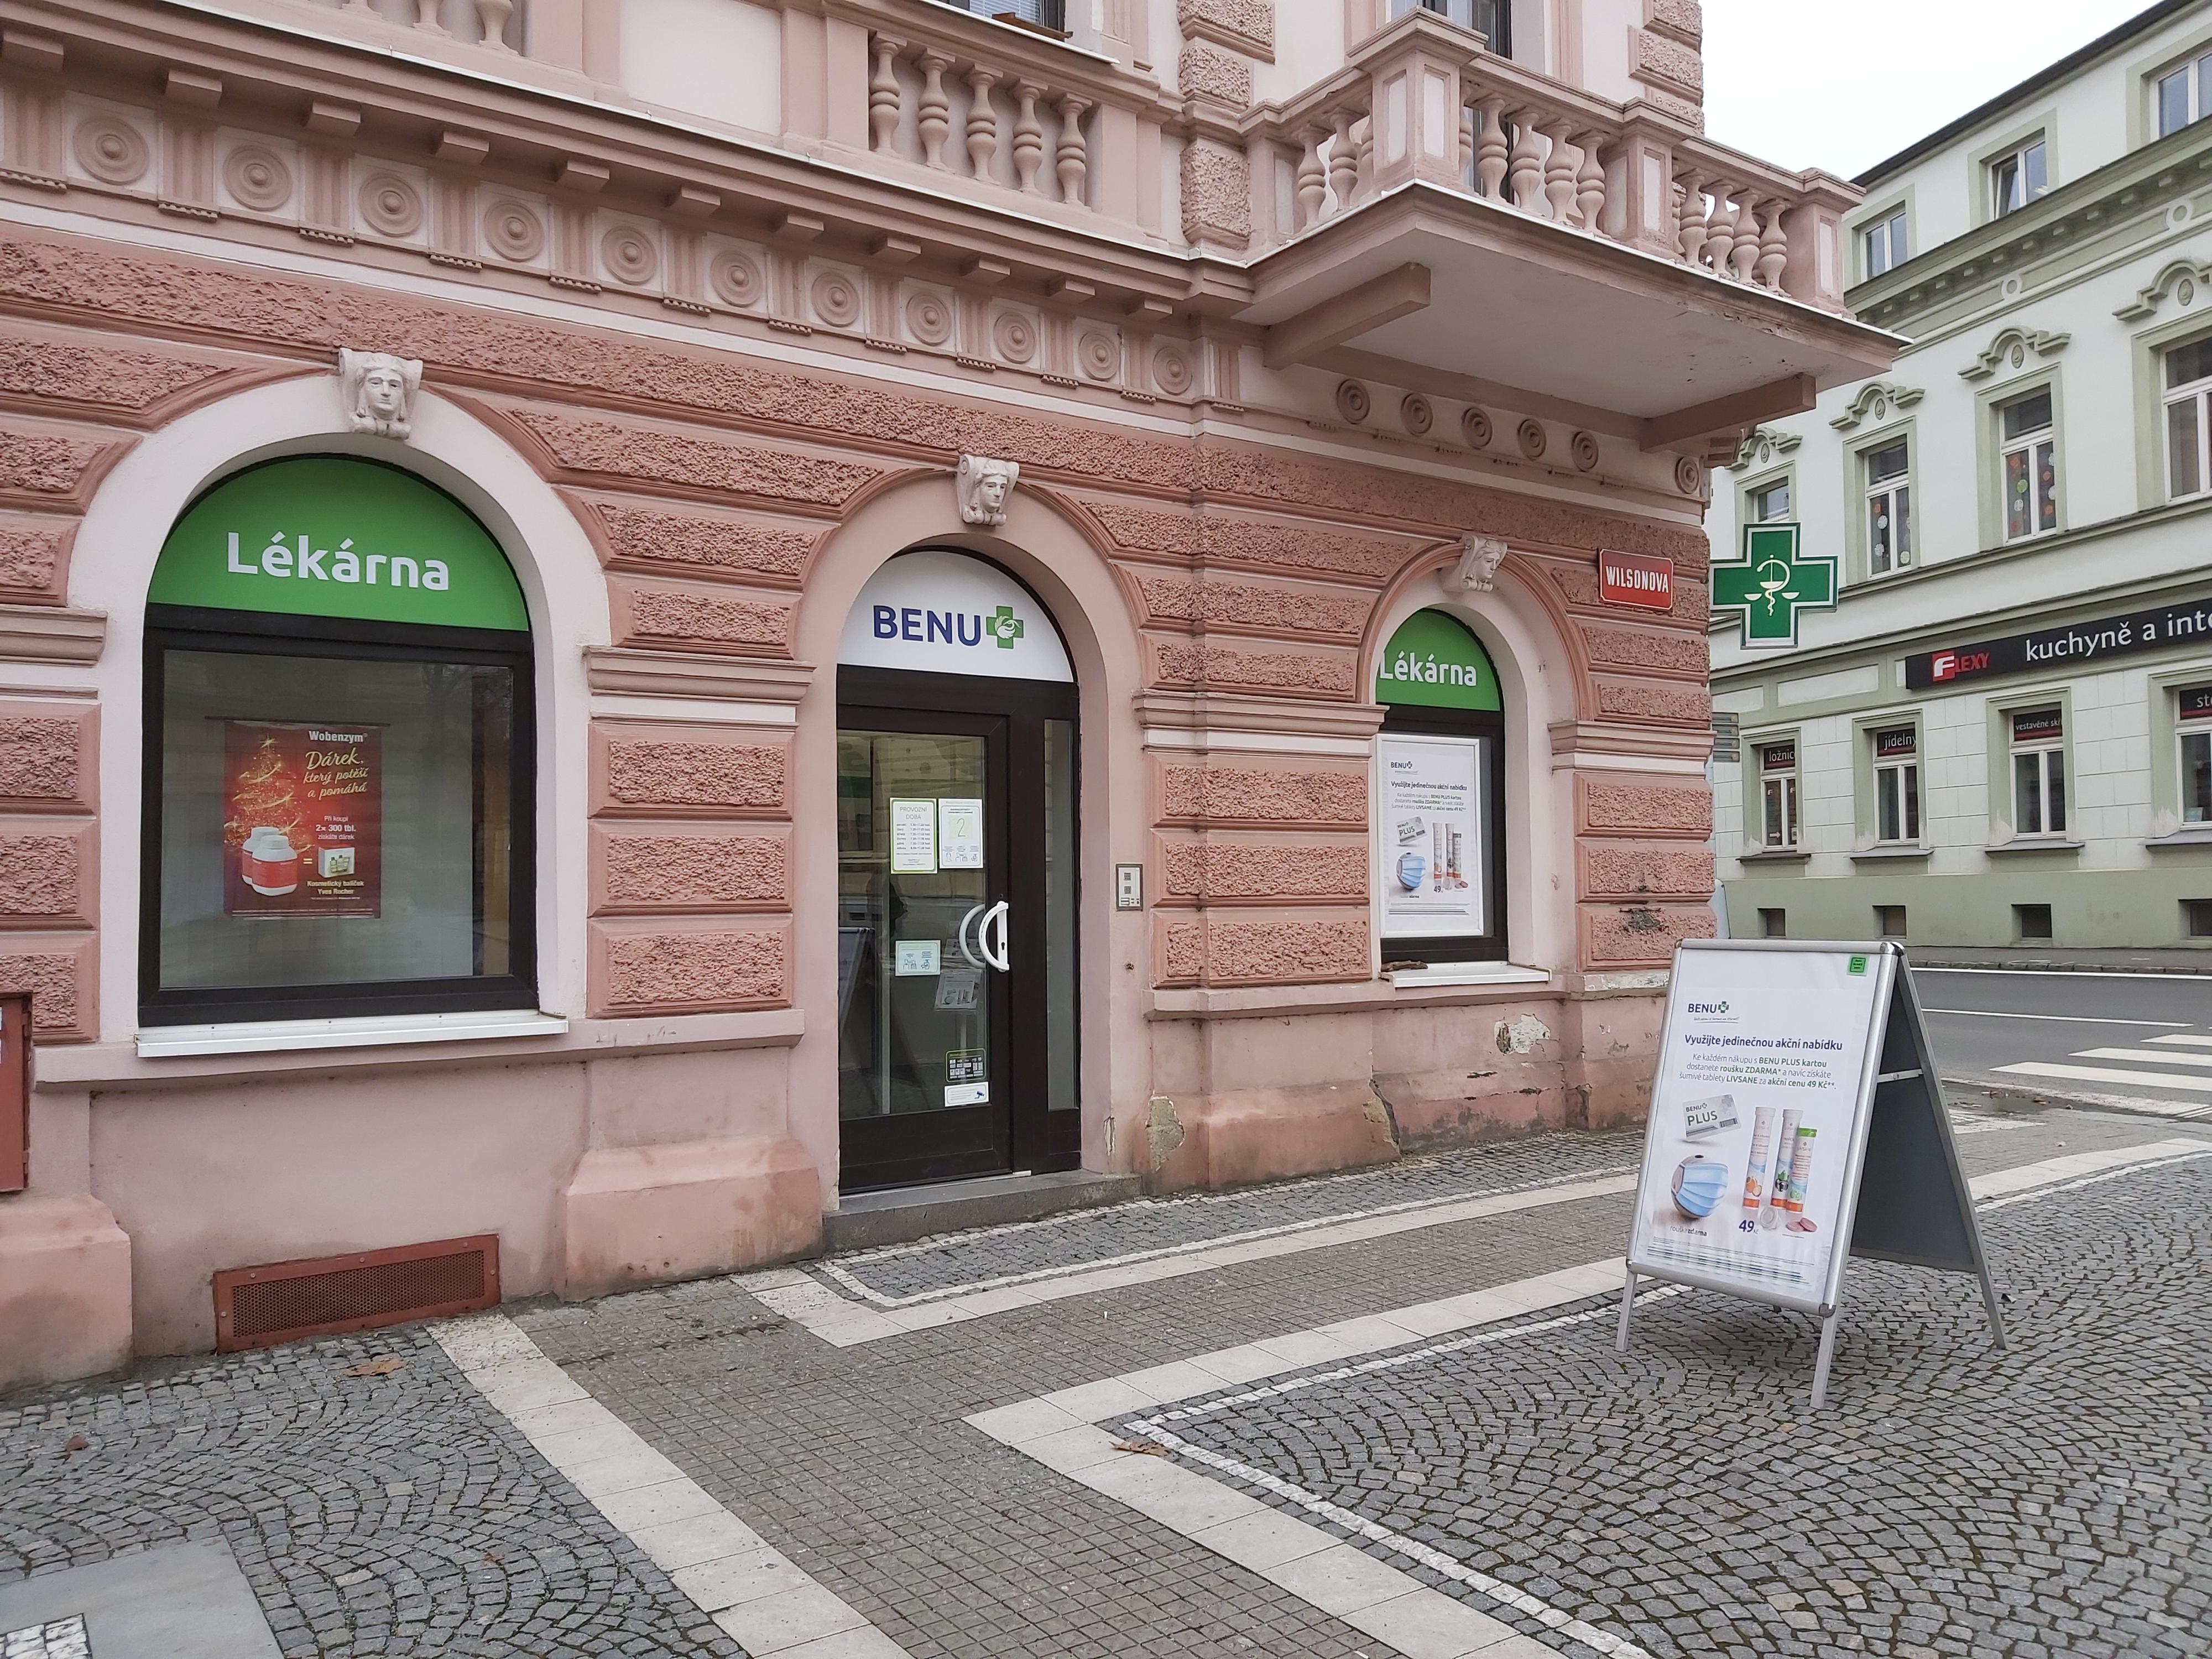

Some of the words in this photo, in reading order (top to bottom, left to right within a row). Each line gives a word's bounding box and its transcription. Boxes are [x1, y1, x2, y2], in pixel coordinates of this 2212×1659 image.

[228, 531, 449, 591] Lékárna
[1605, 565, 1669, 593] WILSONOVA
[873, 605, 981, 646] BENU
[2026, 621, 2132, 661] kuchyně
[2142, 623, 2156, 641] a
[1380, 650, 1477, 687] Lékárna
[1934, 652, 1990, 677] FLEXY
[2197, 693, 2212, 708] st
[1769, 749, 1796, 762] ložnic
[303, 771, 332, 785] který
[335, 768, 369, 784] potěší
[319, 782, 368, 800] pomáhá
[956, 818, 966, 837] 2
[1399, 826, 1416, 837] PLUS
[1688, 1003, 1717, 1013] BENU
[1684, 1034, 1721, 1046] Využijte
[1721, 1035, 1773, 1047] jedinečnou
[1775, 1038, 1801, 1048] akční
[1802, 1039, 1843, 1050] nabídku
[1702, 1053, 1728, 1062] každém
[1728, 1055, 1753, 1064] nákupu
[1759, 1057, 1780, 1065] BENU
[1802, 1058, 1827, 1067] kartou
[1686, 1062, 1719, 1072] dostanete
[1720, 1063, 1744, 1073] roušku
[1788, 1069, 1806, 1077] navíc
[1807, 1069, 1832, 1078] získáte
[1679, 1072, 1702, 1080] šumivé
[1702, 1073, 1726, 1083] tablety
[1726, 1074, 1758, 1084] LIVSANE
[1767, 1077, 1787, 1086] akční
[1788, 1079, 1806, 1088] cenu
[1686, 1104, 1702, 1113] BENU
[1687, 1110, 1718, 1126] PLUS
[1739, 1219, 1754, 1233] 49
